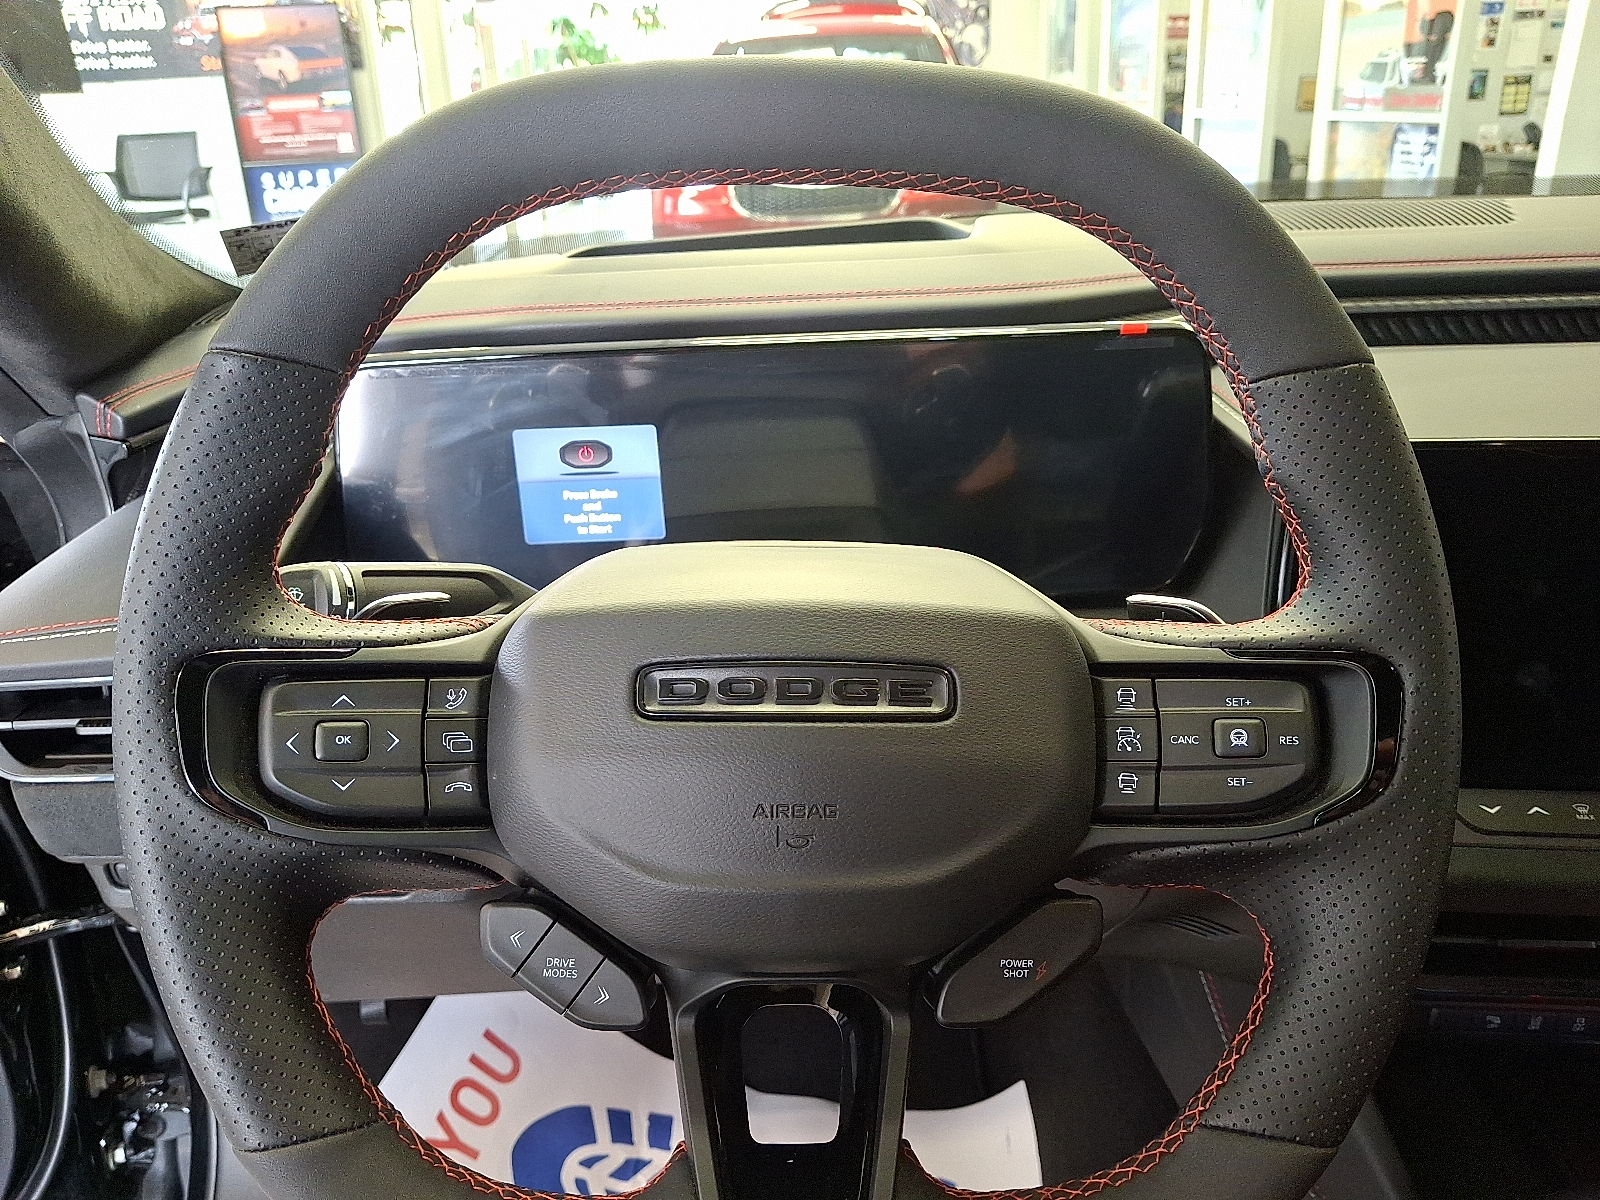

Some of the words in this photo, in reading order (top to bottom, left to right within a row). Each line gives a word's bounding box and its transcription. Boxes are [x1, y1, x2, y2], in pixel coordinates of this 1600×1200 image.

[61, 5, 93, 39] FF
[96, 4, 167, 31] ROAD
[657, 676, 934, 707] DODGE
[335, 735, 352, 745] OK
[1170, 735, 1200, 745] CANC
[1279, 736, 1300, 745] RES
[752, 803, 839, 820] AIRBAG
[546, 957, 576, 968] DRIVE
[1000, 959, 1034, 968] POWER
[543, 968, 578, 979] MODES
[1003, 969, 1030, 978] SHOT
[424, 1027, 523, 1162] YOU
